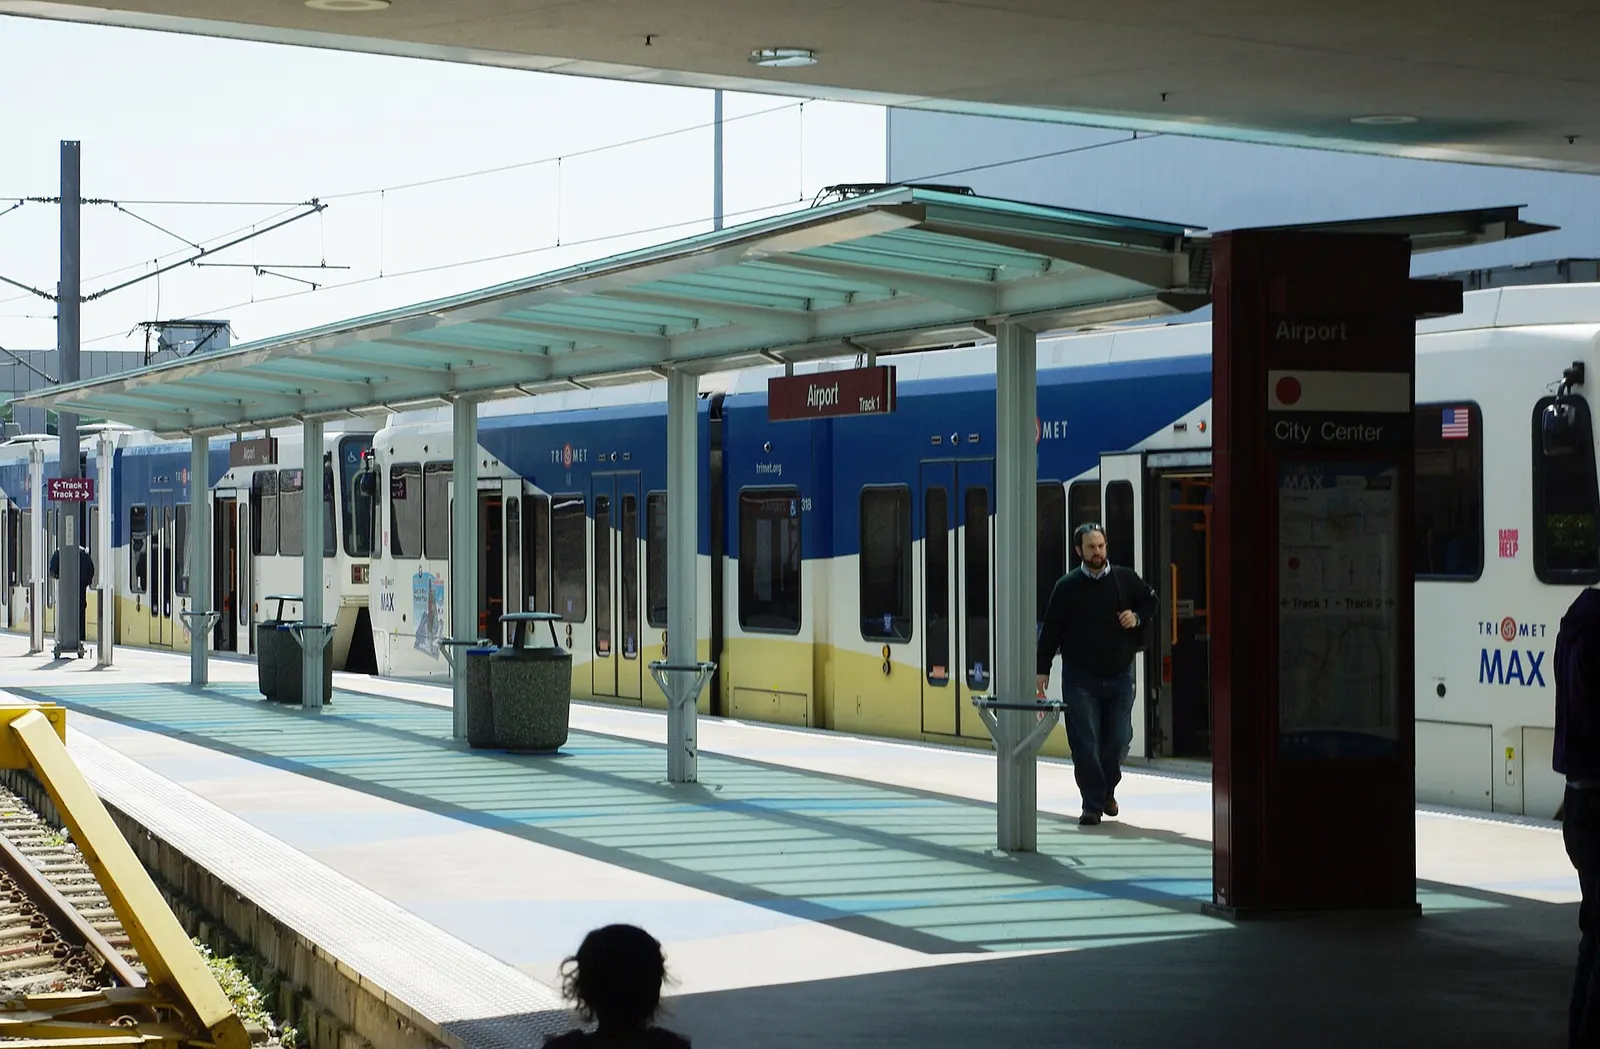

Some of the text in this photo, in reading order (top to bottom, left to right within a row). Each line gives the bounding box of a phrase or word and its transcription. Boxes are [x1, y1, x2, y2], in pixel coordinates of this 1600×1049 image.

[1275, 320, 1348, 345] Airport
[807, 382, 839, 411] Airport
[859, 396, 880, 412] Track 1
[1042, 420, 1068, 440] MET
[1274, 420, 1384, 444] City Center
[551, 448, 588, 464] TRI MET
[755, 462, 782, 477] trimet.org
[61, 481, 89, 490] Track 1
[1283, 474, 1324, 492] MAX
[52, 490, 73, 499] Track
[801, 498, 812, 512] 318
[1498, 528, 1518, 541] RADIO
[1498, 541, 1518, 559] HELP
[380, 592, 395, 612] MAX
[1292, 598, 1320, 609] Track
[1324, 598, 1328, 608] 1
[1345, 598, 1372, 609] Track
[1478, 621, 1546, 638] TRI MET
[1479, 647, 1546, 688] MAX
